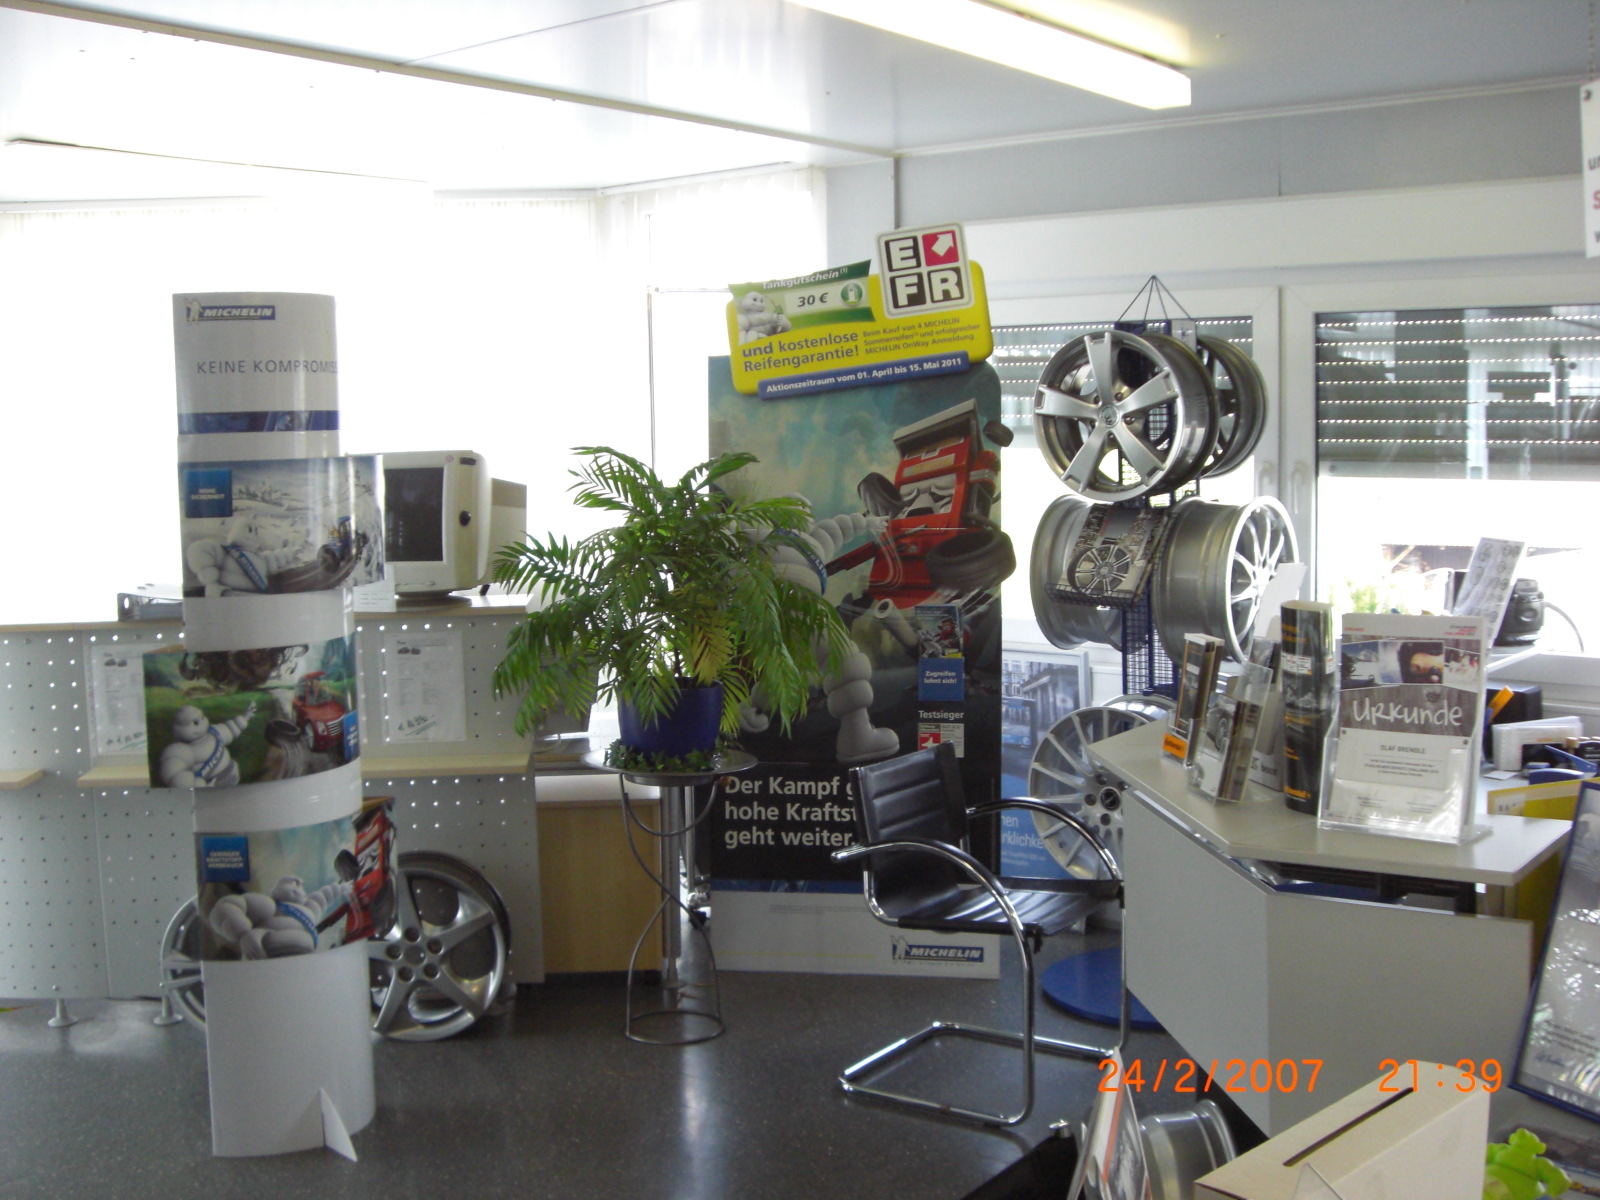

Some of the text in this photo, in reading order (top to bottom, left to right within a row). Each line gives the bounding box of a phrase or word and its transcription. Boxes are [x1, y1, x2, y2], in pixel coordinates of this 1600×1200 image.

[762, 270, 839, 290] Tankgutschein
[797, 292, 829, 308] 30 €
[203, 307, 273, 318] MICHELIN
[862, 330, 881, 338] Beim
[882, 326, 900, 334] Kauf
[902, 324, 916, 332] von
[923, 317, 960, 328] MICHELIN
[919, 330, 934, 338] und
[935, 323, 981, 336] erfolgreicher
[741, 332, 858, 358] und kostenlose
[865, 334, 974, 355] MICHELIN OnWay Anmeldung
[196, 360, 246, 374] KEINE
[743, 344, 859, 373] Reifengarantie!
[766, 357, 962, 393] Aktionszeitraum vom 01. April bis 15. Mai 2011
[924, 670, 957, 679] Zugreifen
[918, 709, 965, 721] Testsieger
[724, 776, 762, 794] Der
[769, 776, 840, 799] Kampf
[724, 801, 779, 820] hohe
[724, 826, 856, 849] geht weiter.
[910, 946, 982, 958] MICHELIN
